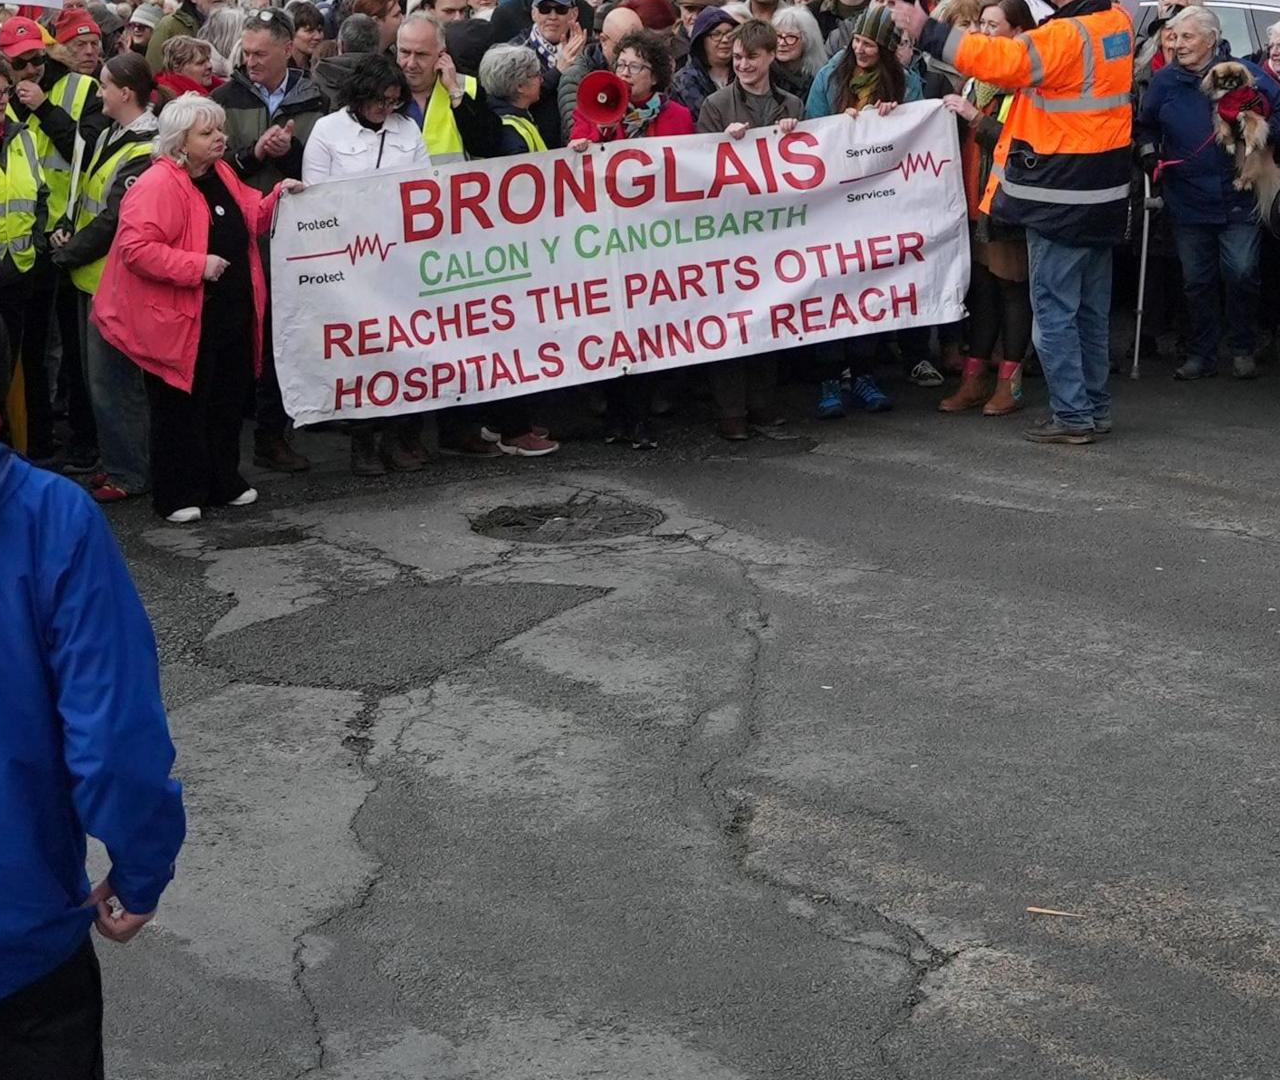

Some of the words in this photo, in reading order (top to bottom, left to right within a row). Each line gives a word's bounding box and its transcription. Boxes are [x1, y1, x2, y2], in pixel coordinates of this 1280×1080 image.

[846, 144, 894, 158] Services
[400, 129, 827, 243] BRONGLAIS
[846, 188, 896, 203] Services
[297, 216, 340, 232] Protect
[420, 241, 529, 286] CALON
[540, 235, 560, 264] Y
[574, 204, 808, 259] CANOLBARTH
[299, 270, 345, 286] Protect
[323, 295, 516, 360] REACHES
[526, 278, 609, 323] THE
[624, 255, 761, 310] PARTS
[774, 231, 926, 284] OTHER
[334, 341, 565, 411] HOSPITALS
[577, 309, 754, 372] CANNOT
[770, 282, 918, 338] REACH
